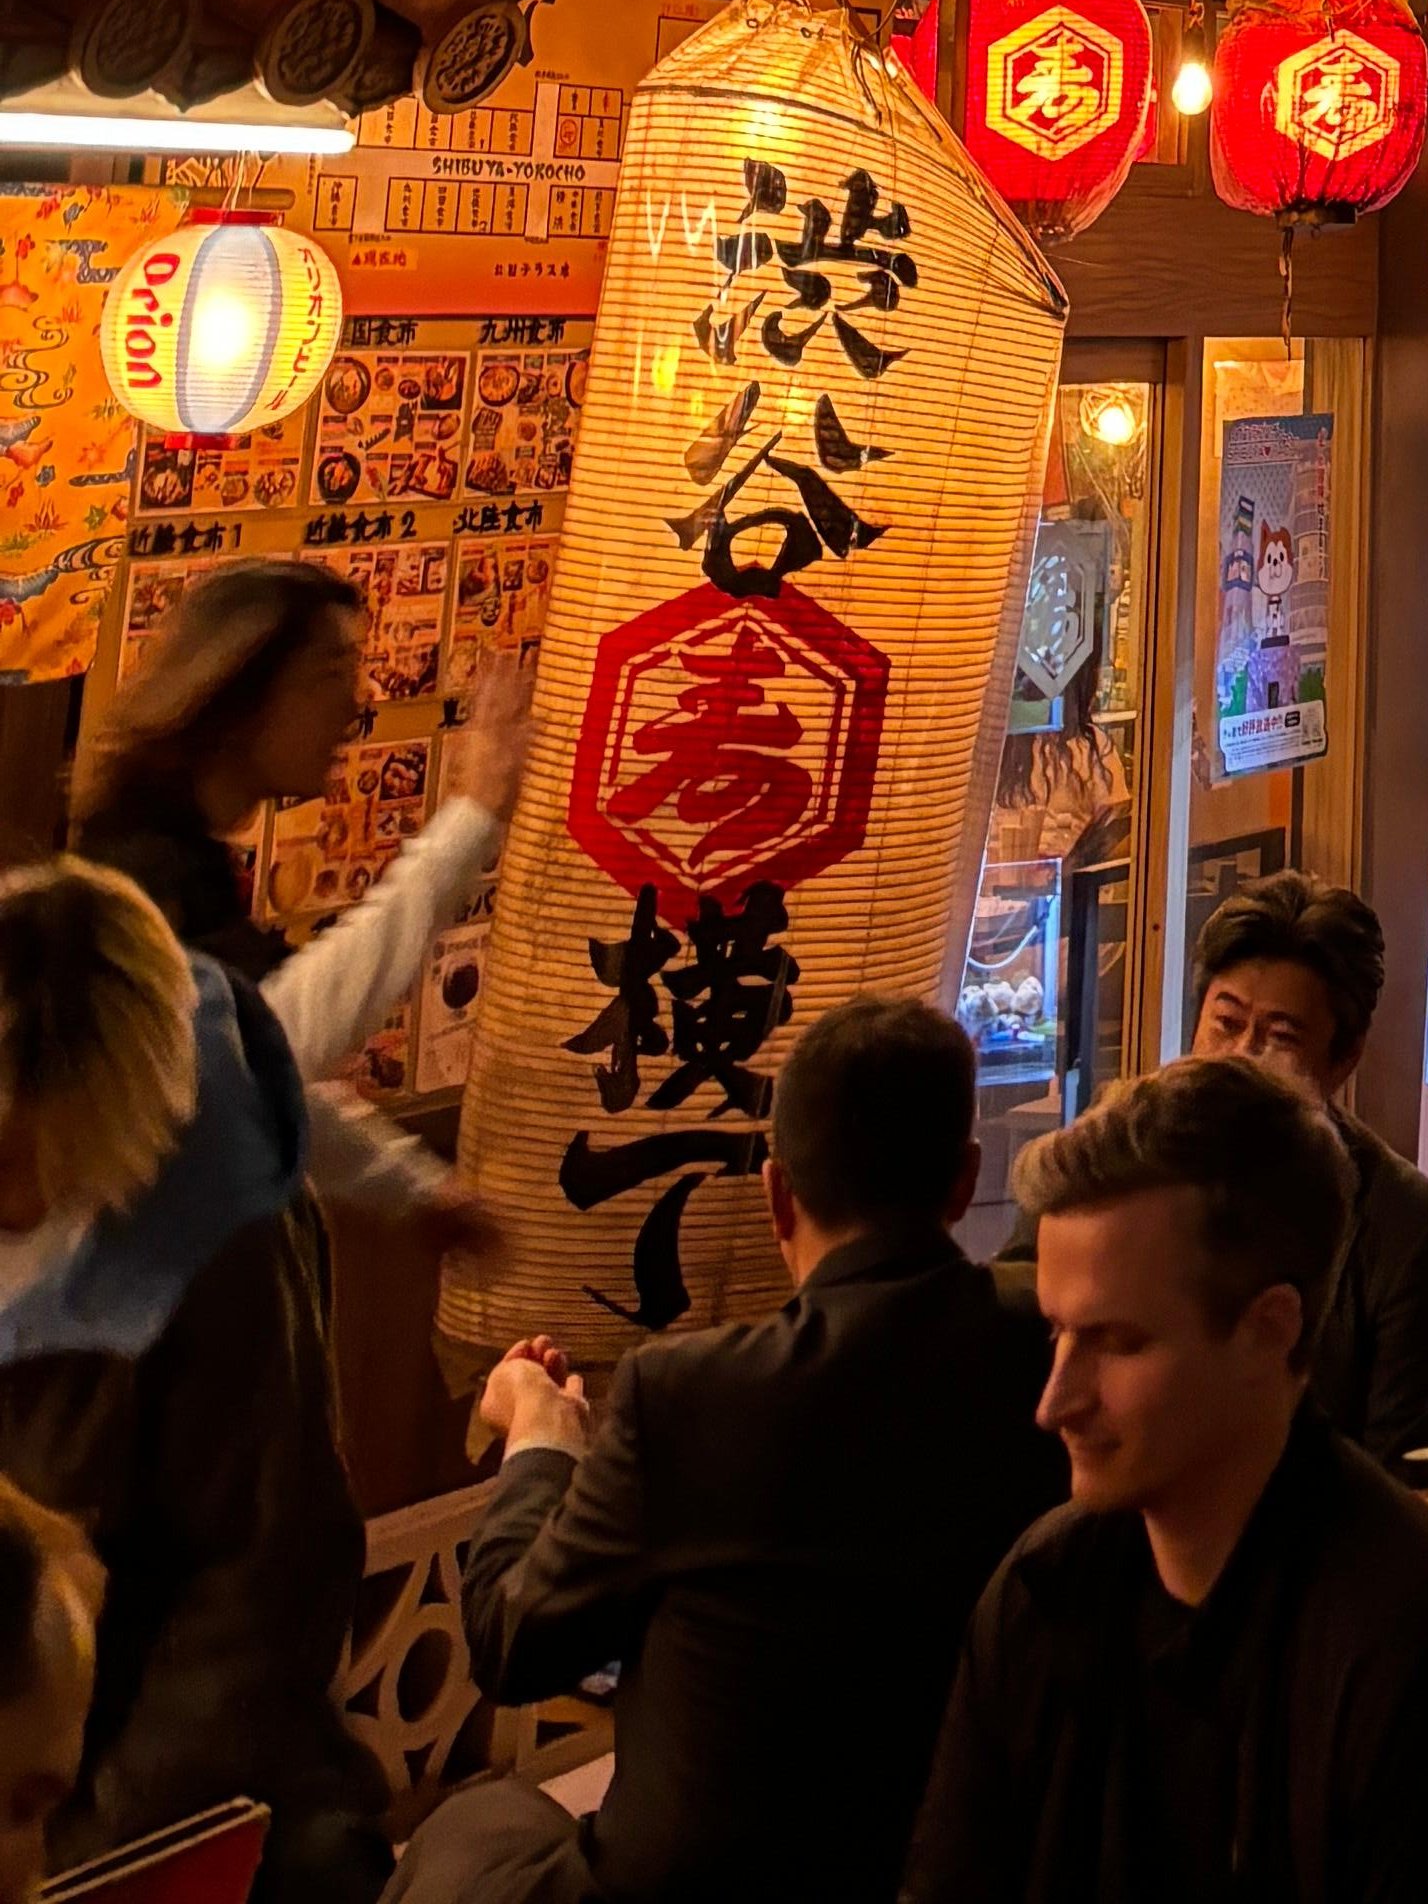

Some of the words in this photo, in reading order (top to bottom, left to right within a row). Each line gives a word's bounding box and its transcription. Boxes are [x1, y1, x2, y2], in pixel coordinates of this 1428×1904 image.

[431, 155, 587, 183] SHIBUYA-YOKOCHO
[125, 252, 181, 389] Orion
[343, 318, 418, 347] 国食市
[478, 317, 565, 348] 九州食市
[662, 155, 920, 600] 渋谷
[557, 882, 804, 1334] 横丁
